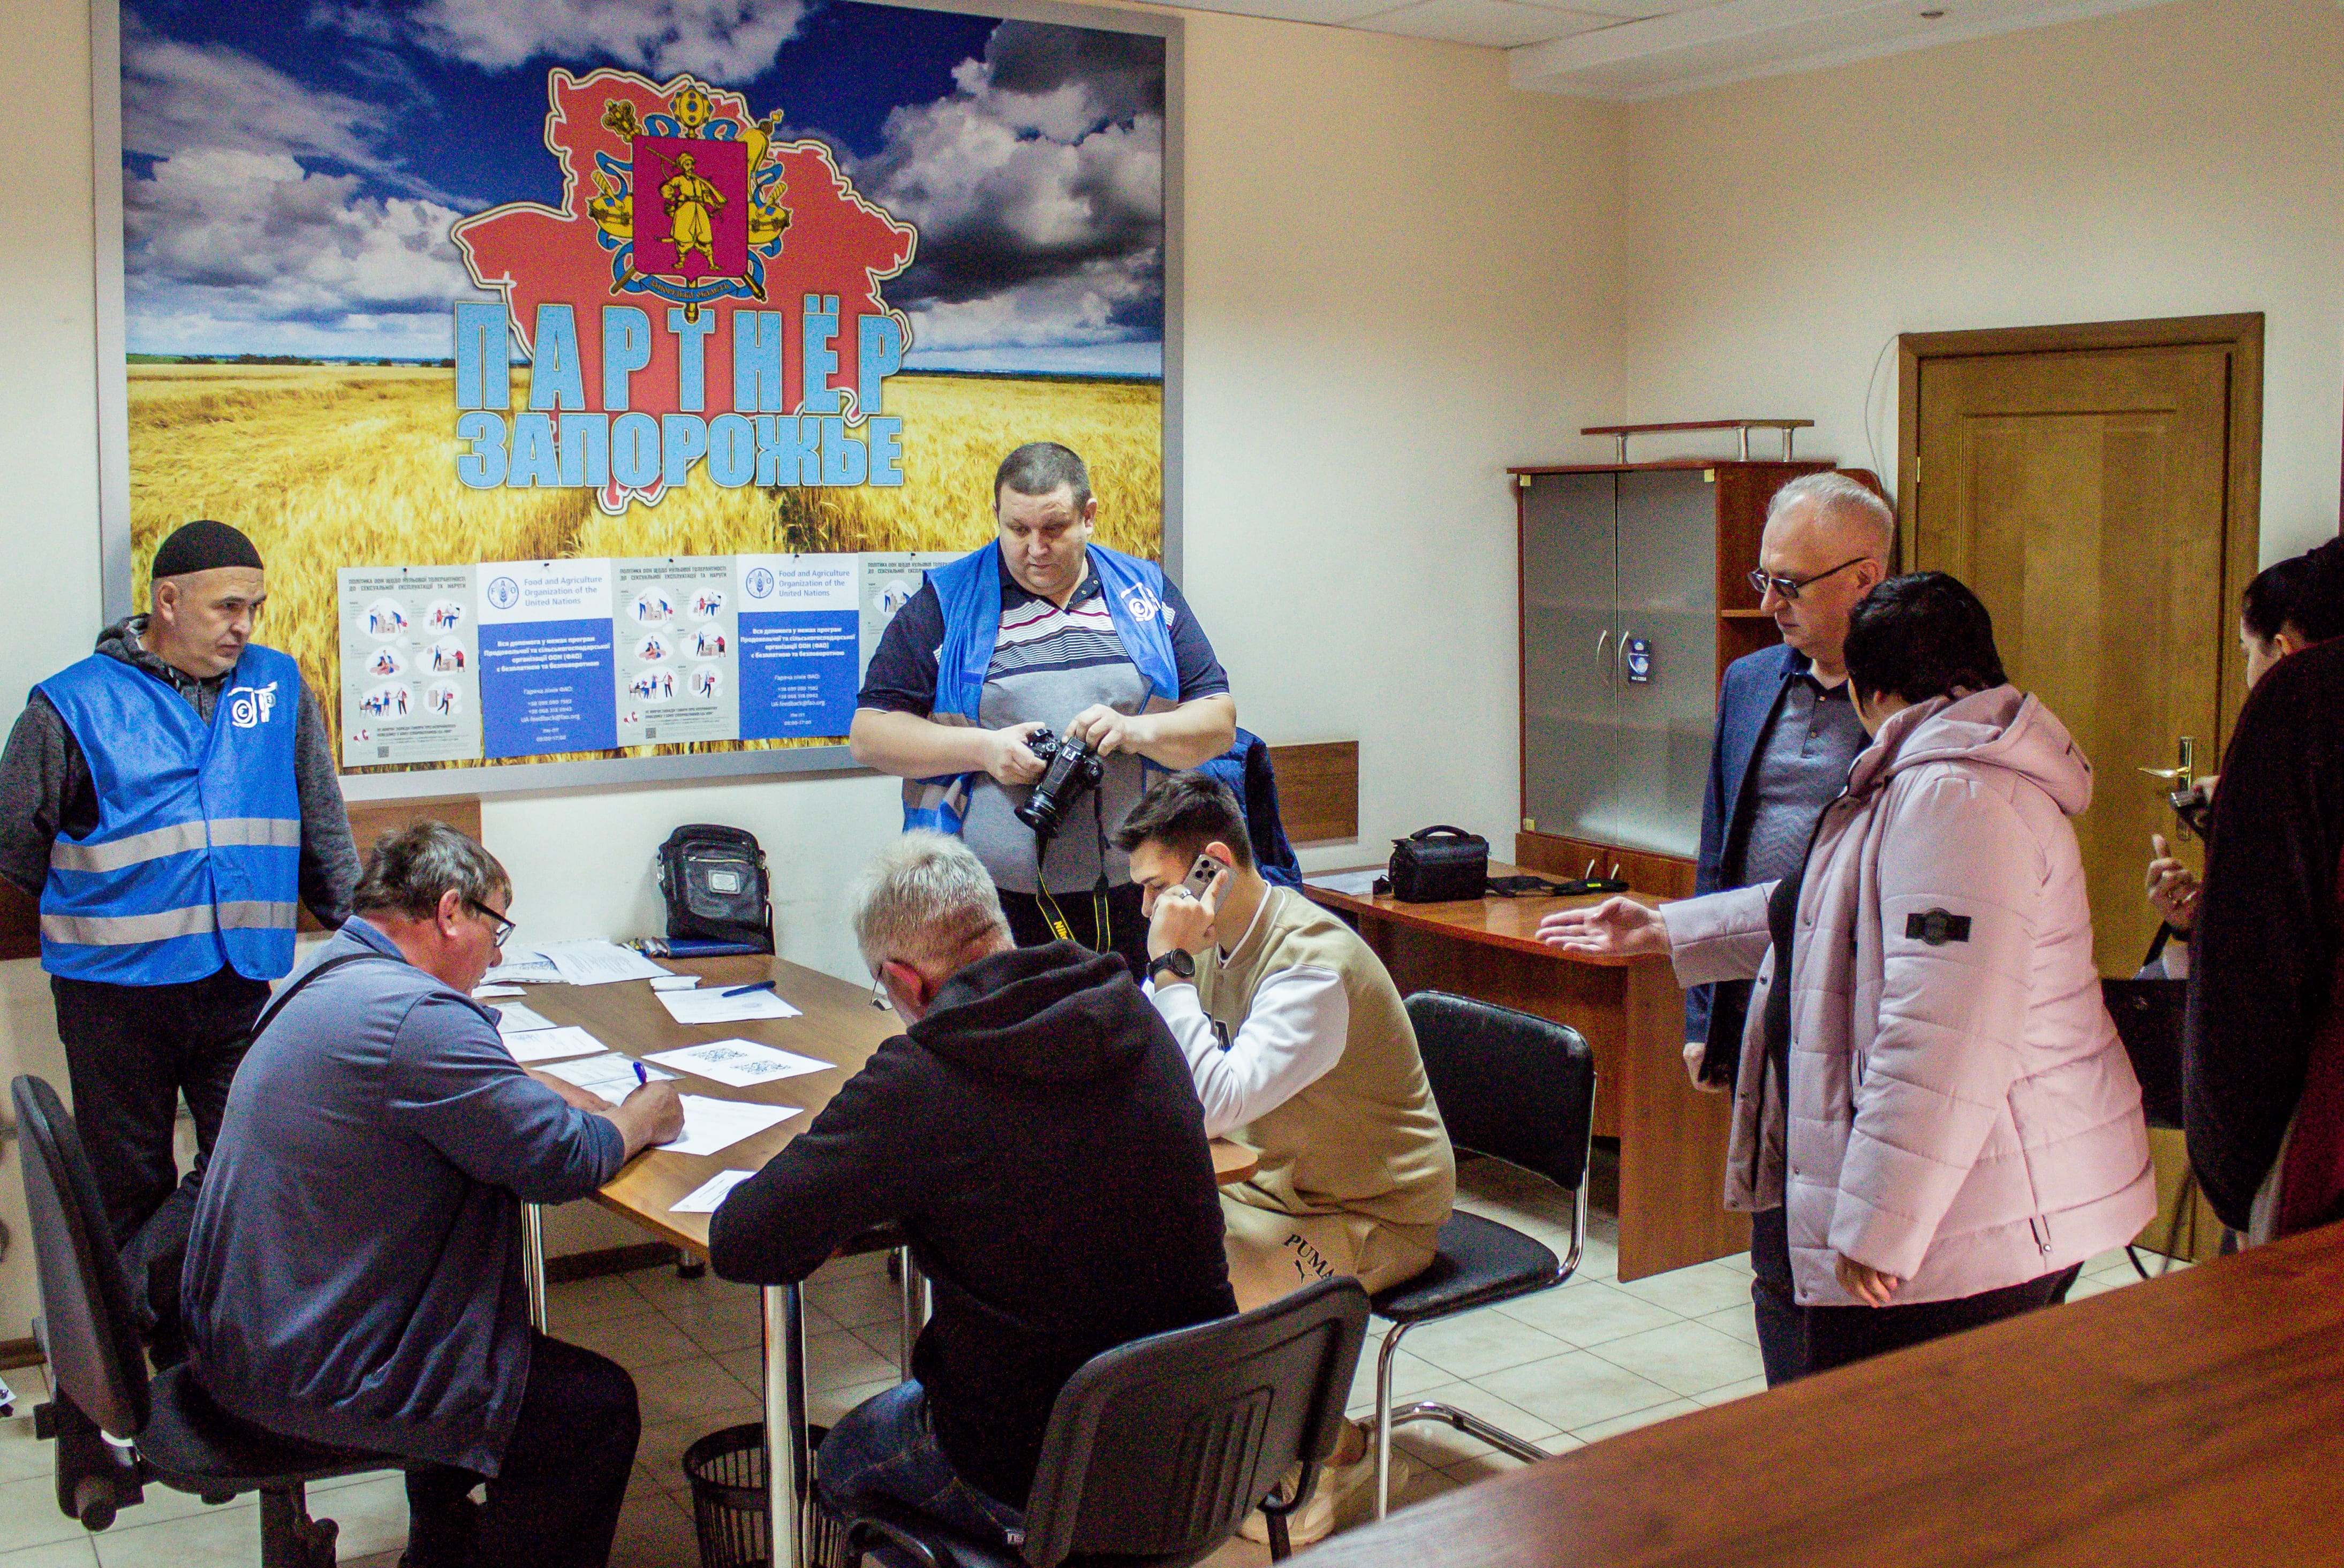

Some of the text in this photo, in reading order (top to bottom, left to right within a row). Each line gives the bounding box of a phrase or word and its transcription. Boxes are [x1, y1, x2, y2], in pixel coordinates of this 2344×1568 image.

[454, 294, 902, 414] ПАРТНЁР
[455, 412, 904, 489] ЗАПОРОЖЬЕ
[812, 570, 850, 578] Agriculture
[561, 576, 602, 585] Agriculture
[779, 580, 822, 589] Organization
[525, 587, 572, 597] Organization
[525, 599, 549, 607] United
